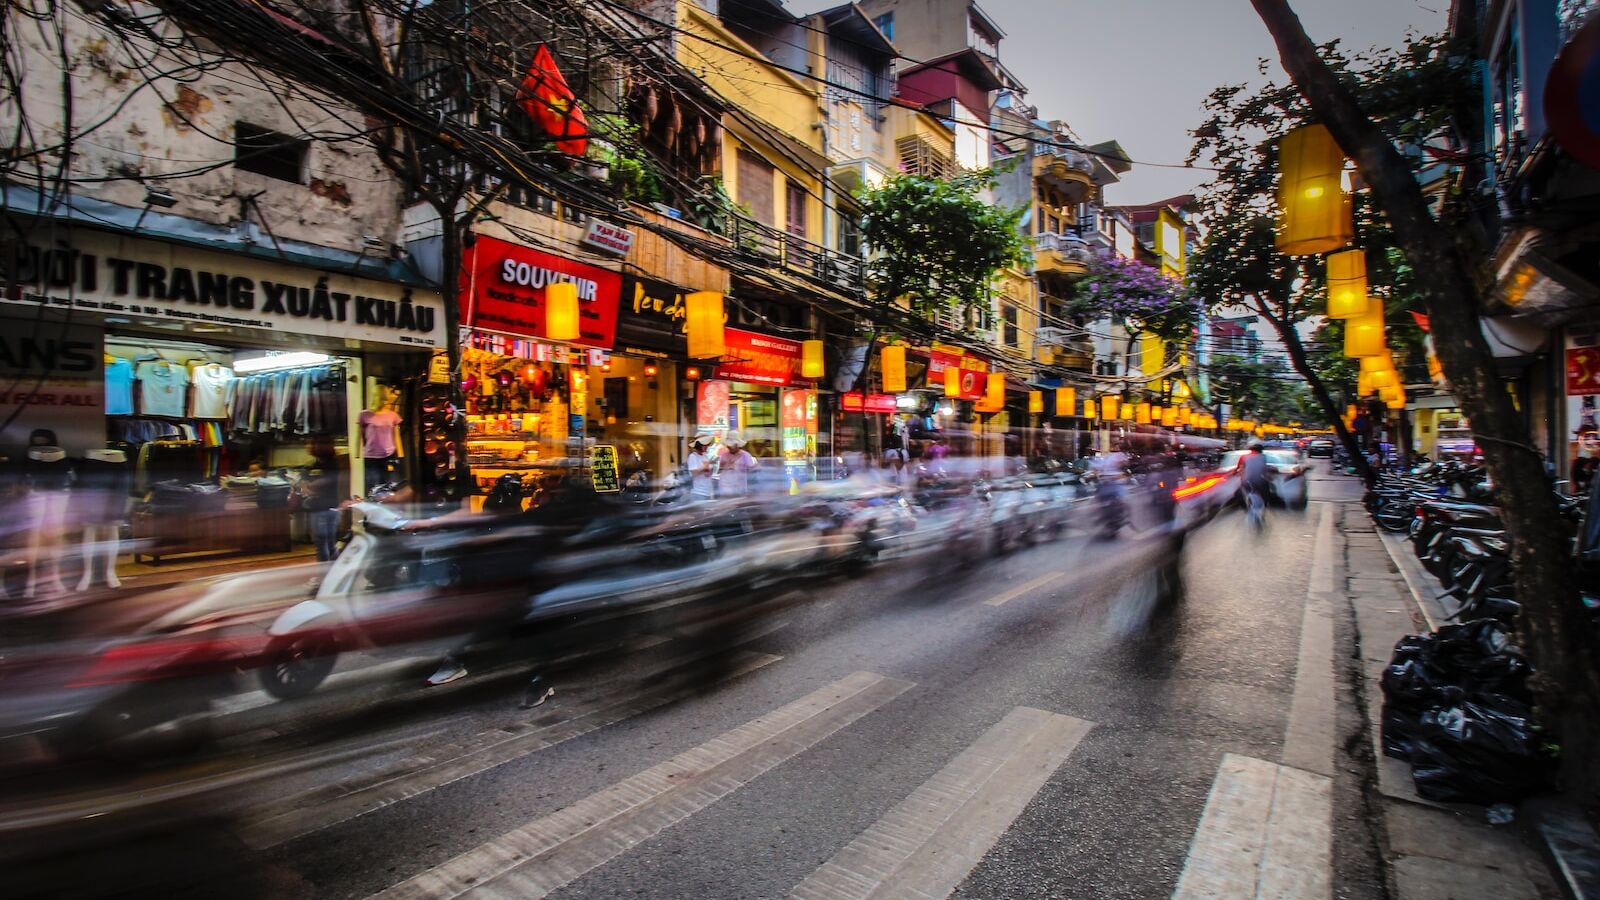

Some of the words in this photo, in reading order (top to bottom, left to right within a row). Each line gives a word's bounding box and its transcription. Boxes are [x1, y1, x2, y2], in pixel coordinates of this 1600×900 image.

[106, 258, 255, 310] TRANG
[260, 274, 351, 322] XUẤT
[355, 283, 434, 333] KHẨU
